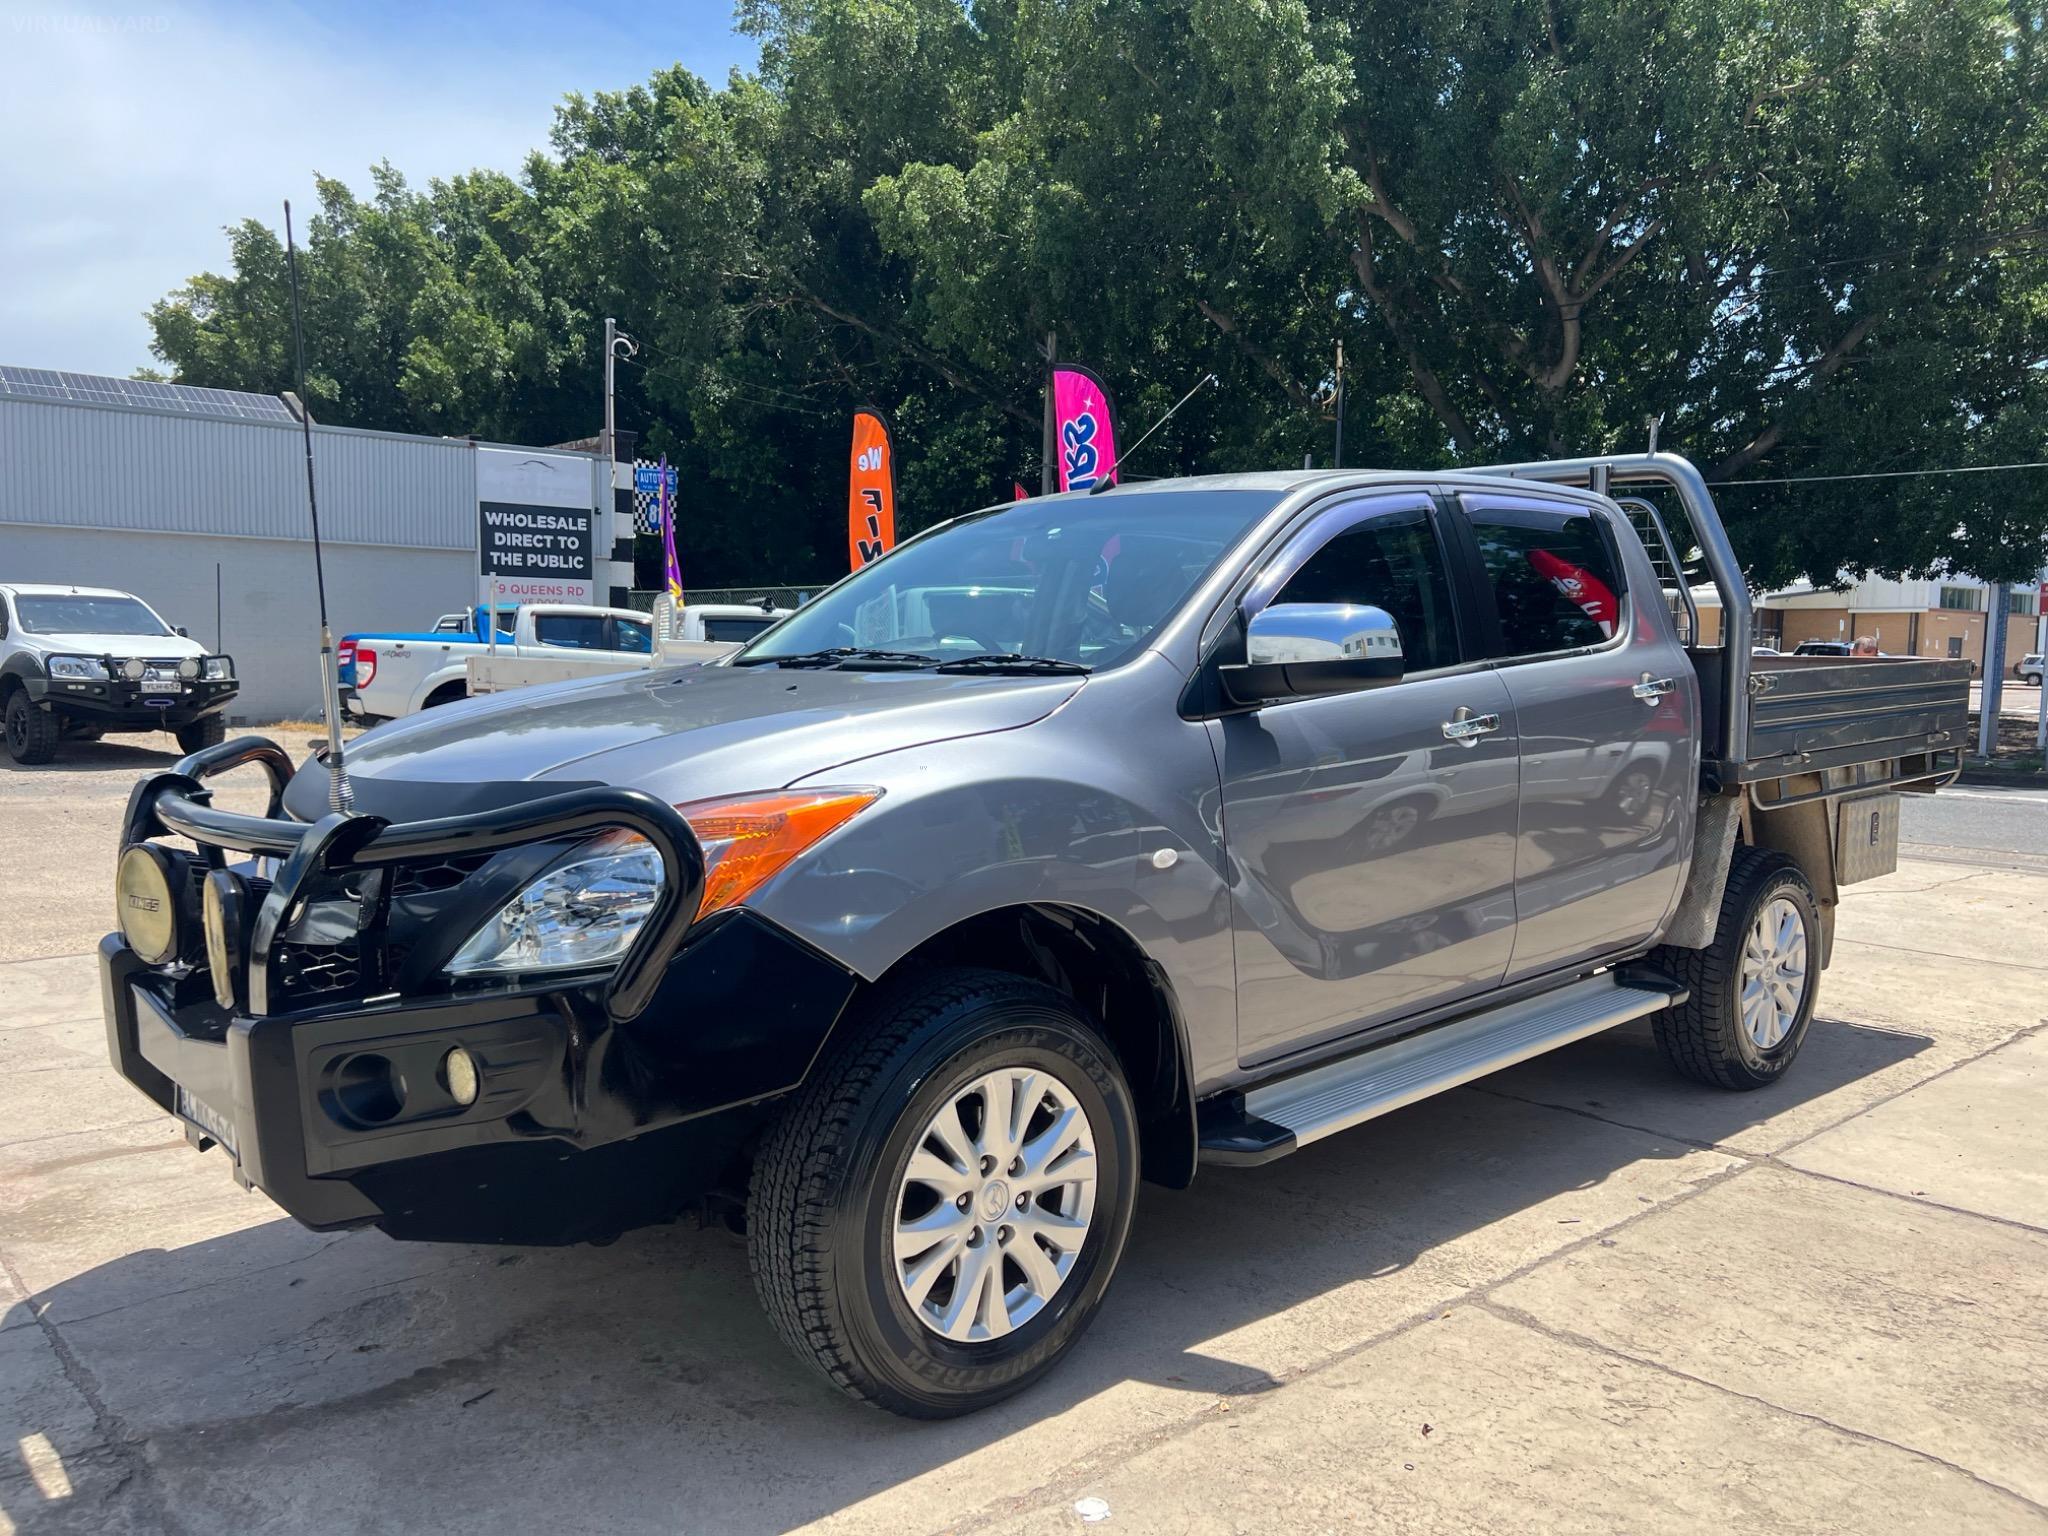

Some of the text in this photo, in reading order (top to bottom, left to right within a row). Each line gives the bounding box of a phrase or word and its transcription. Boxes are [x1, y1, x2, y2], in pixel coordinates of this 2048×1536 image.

[485, 511, 588, 532] WHOLESALE
[494, 531, 580, 550] DIRECT TO
[489, 551, 584, 570] THE PUBLIC
[510, 584, 563, 596] QUEENS
[567, 586, 584, 597] RD
